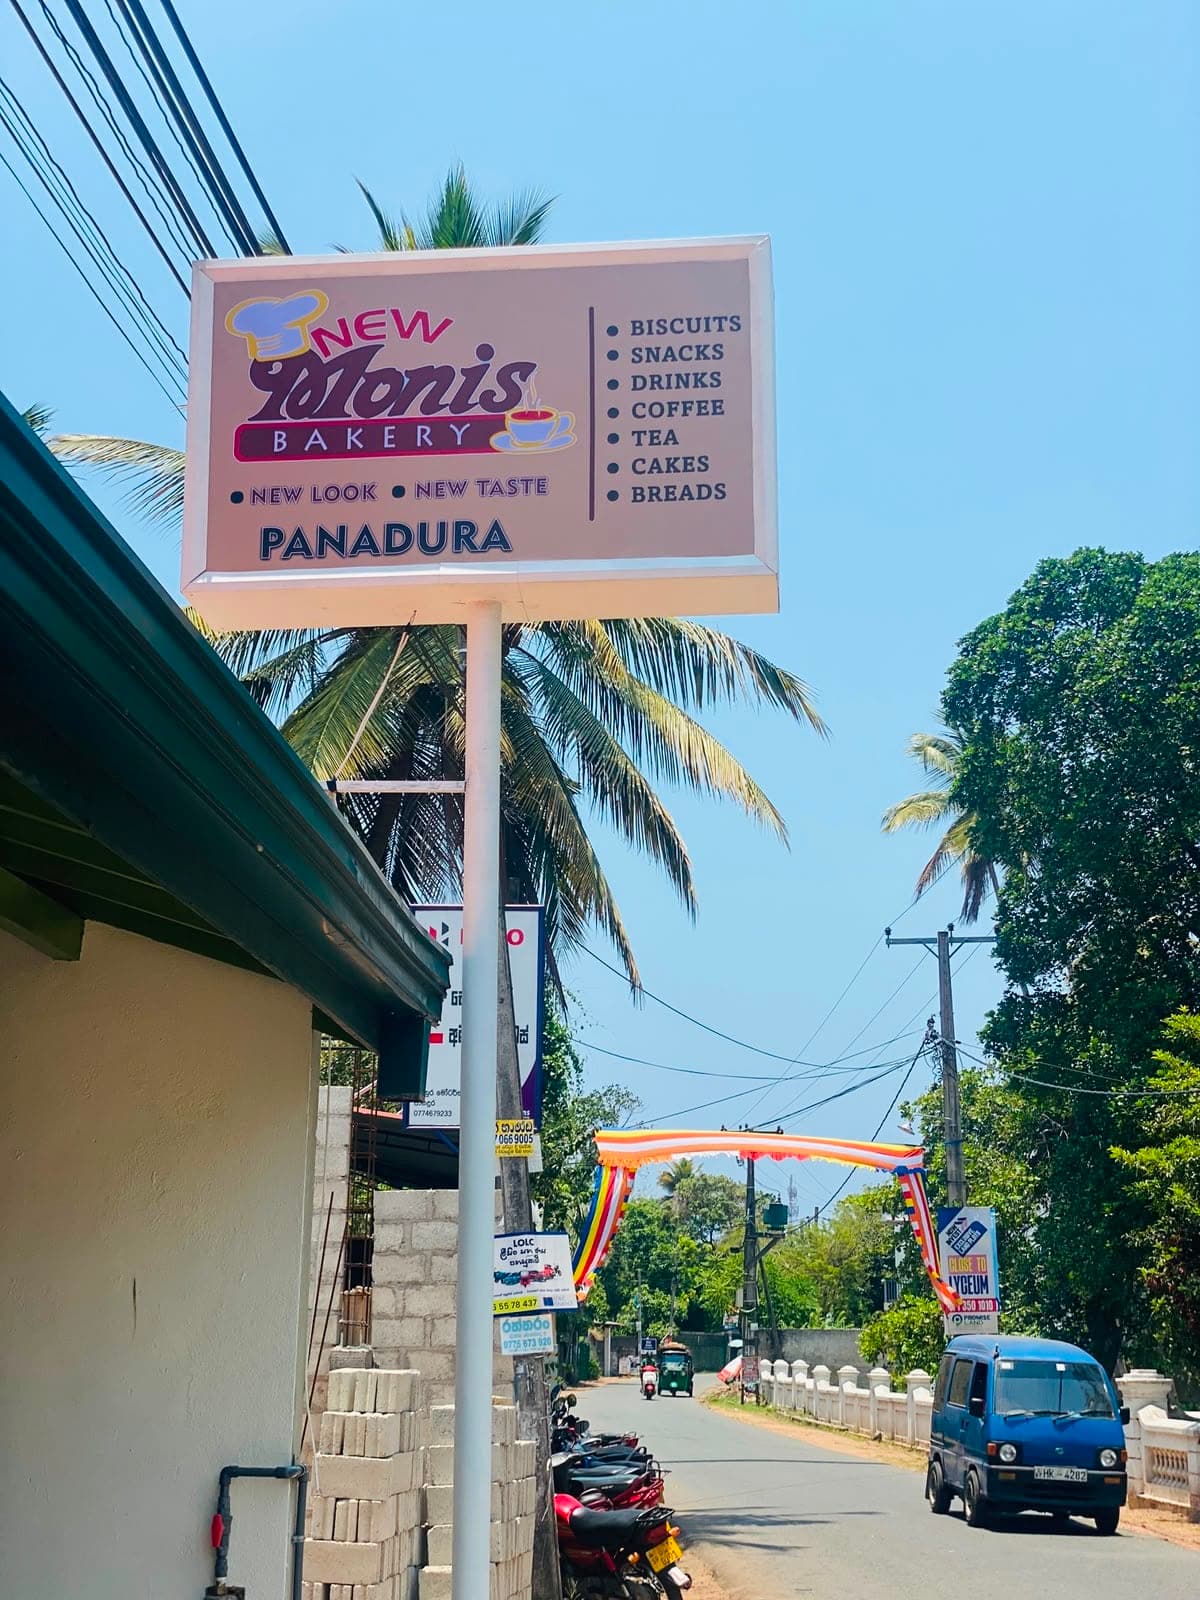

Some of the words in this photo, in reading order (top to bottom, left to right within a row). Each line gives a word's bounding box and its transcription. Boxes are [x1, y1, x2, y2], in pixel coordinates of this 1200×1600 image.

[309, 308, 454, 359] NEW
[630, 315, 742, 337] BISCUITS
[631, 343, 725, 364] SNACKS
[247, 342, 537, 421] Monis
[631, 371, 722, 392] DRINKS
[631, 399, 726, 419] COFFEE
[273, 423, 471, 453] BAKERY
[631, 429, 680, 447] TEA
[631, 455, 710, 475] CAKES
[250, 486, 304, 506] NEW
[311, 483, 379, 503] LOOK
[415, 480, 468, 499] NEW
[476, 476, 549, 497] TASTE
[631, 483, 727, 503] BREADS
[259, 518, 513, 561] PANADURA
[513, 1238, 535, 1248] LOLC
[949, 1257, 973, 1274] CLOSE
[976, 1256, 987, 1273] TO
